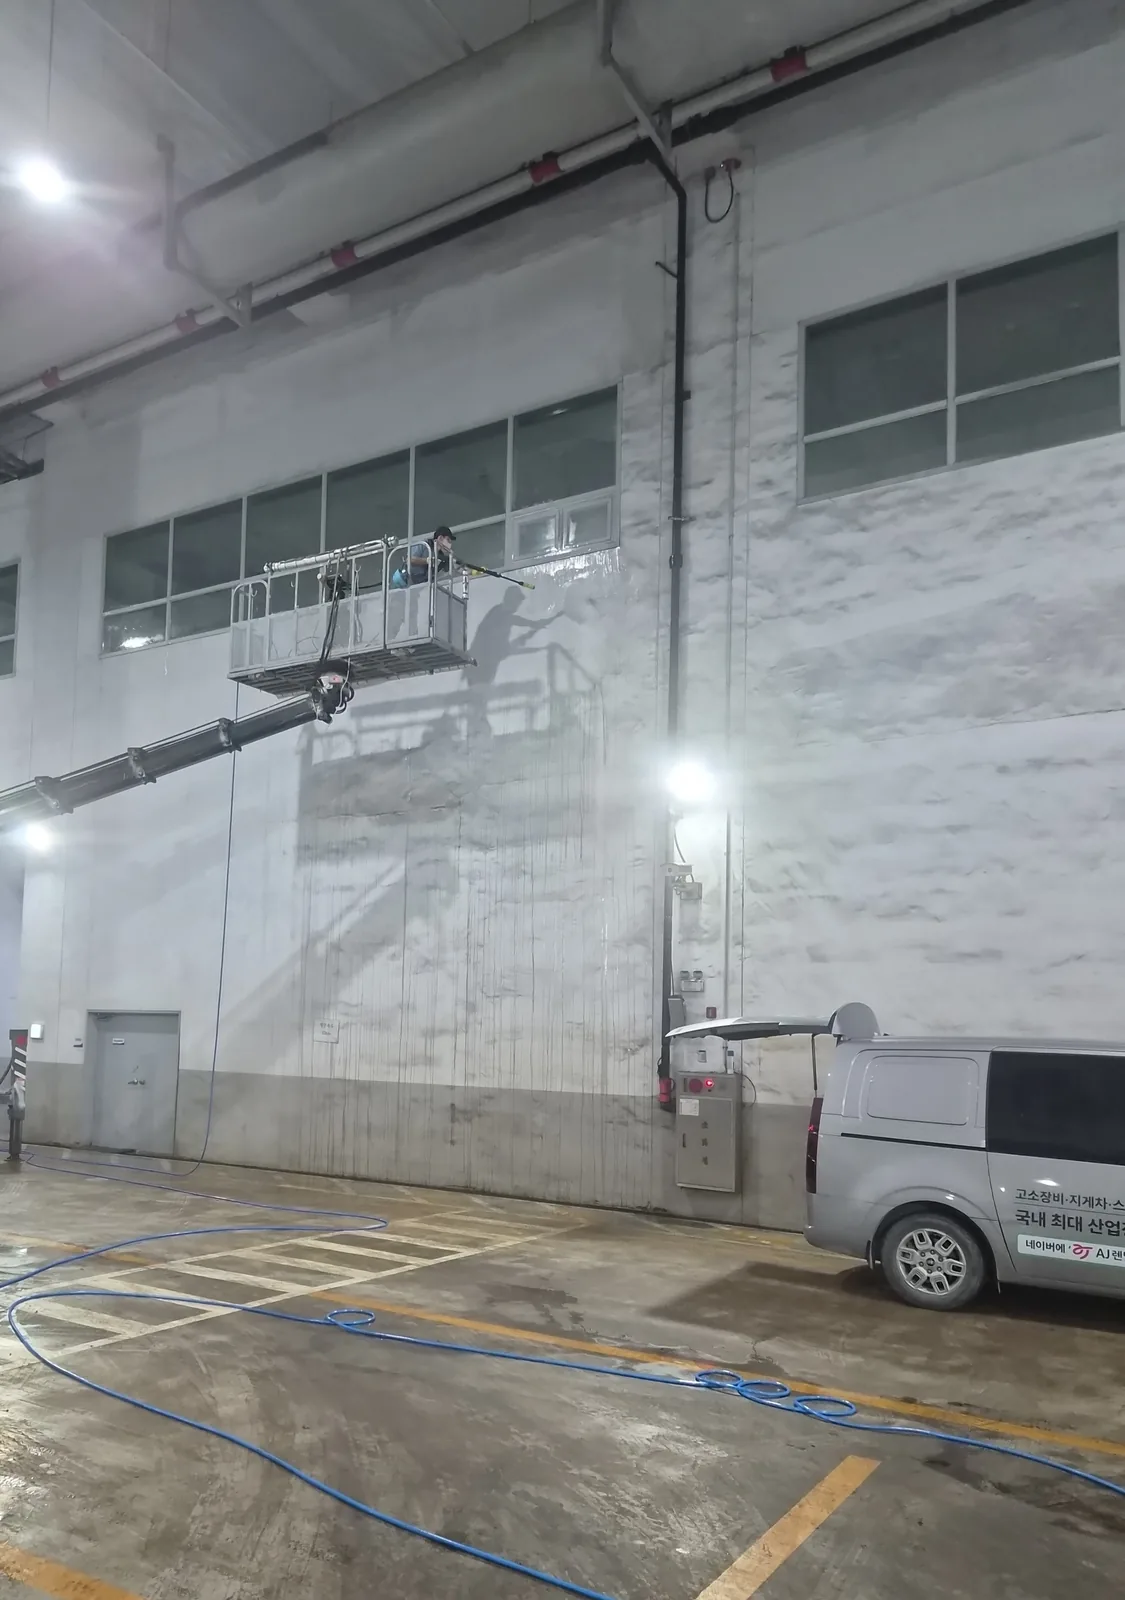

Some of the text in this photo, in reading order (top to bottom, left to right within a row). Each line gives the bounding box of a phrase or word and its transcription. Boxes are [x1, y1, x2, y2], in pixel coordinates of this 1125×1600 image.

[1015, 1209, 1046, 1228] 국내
[1051, 1213, 1083, 1233] 최대
[1025, 1240, 1066, 1254] 네이버에
